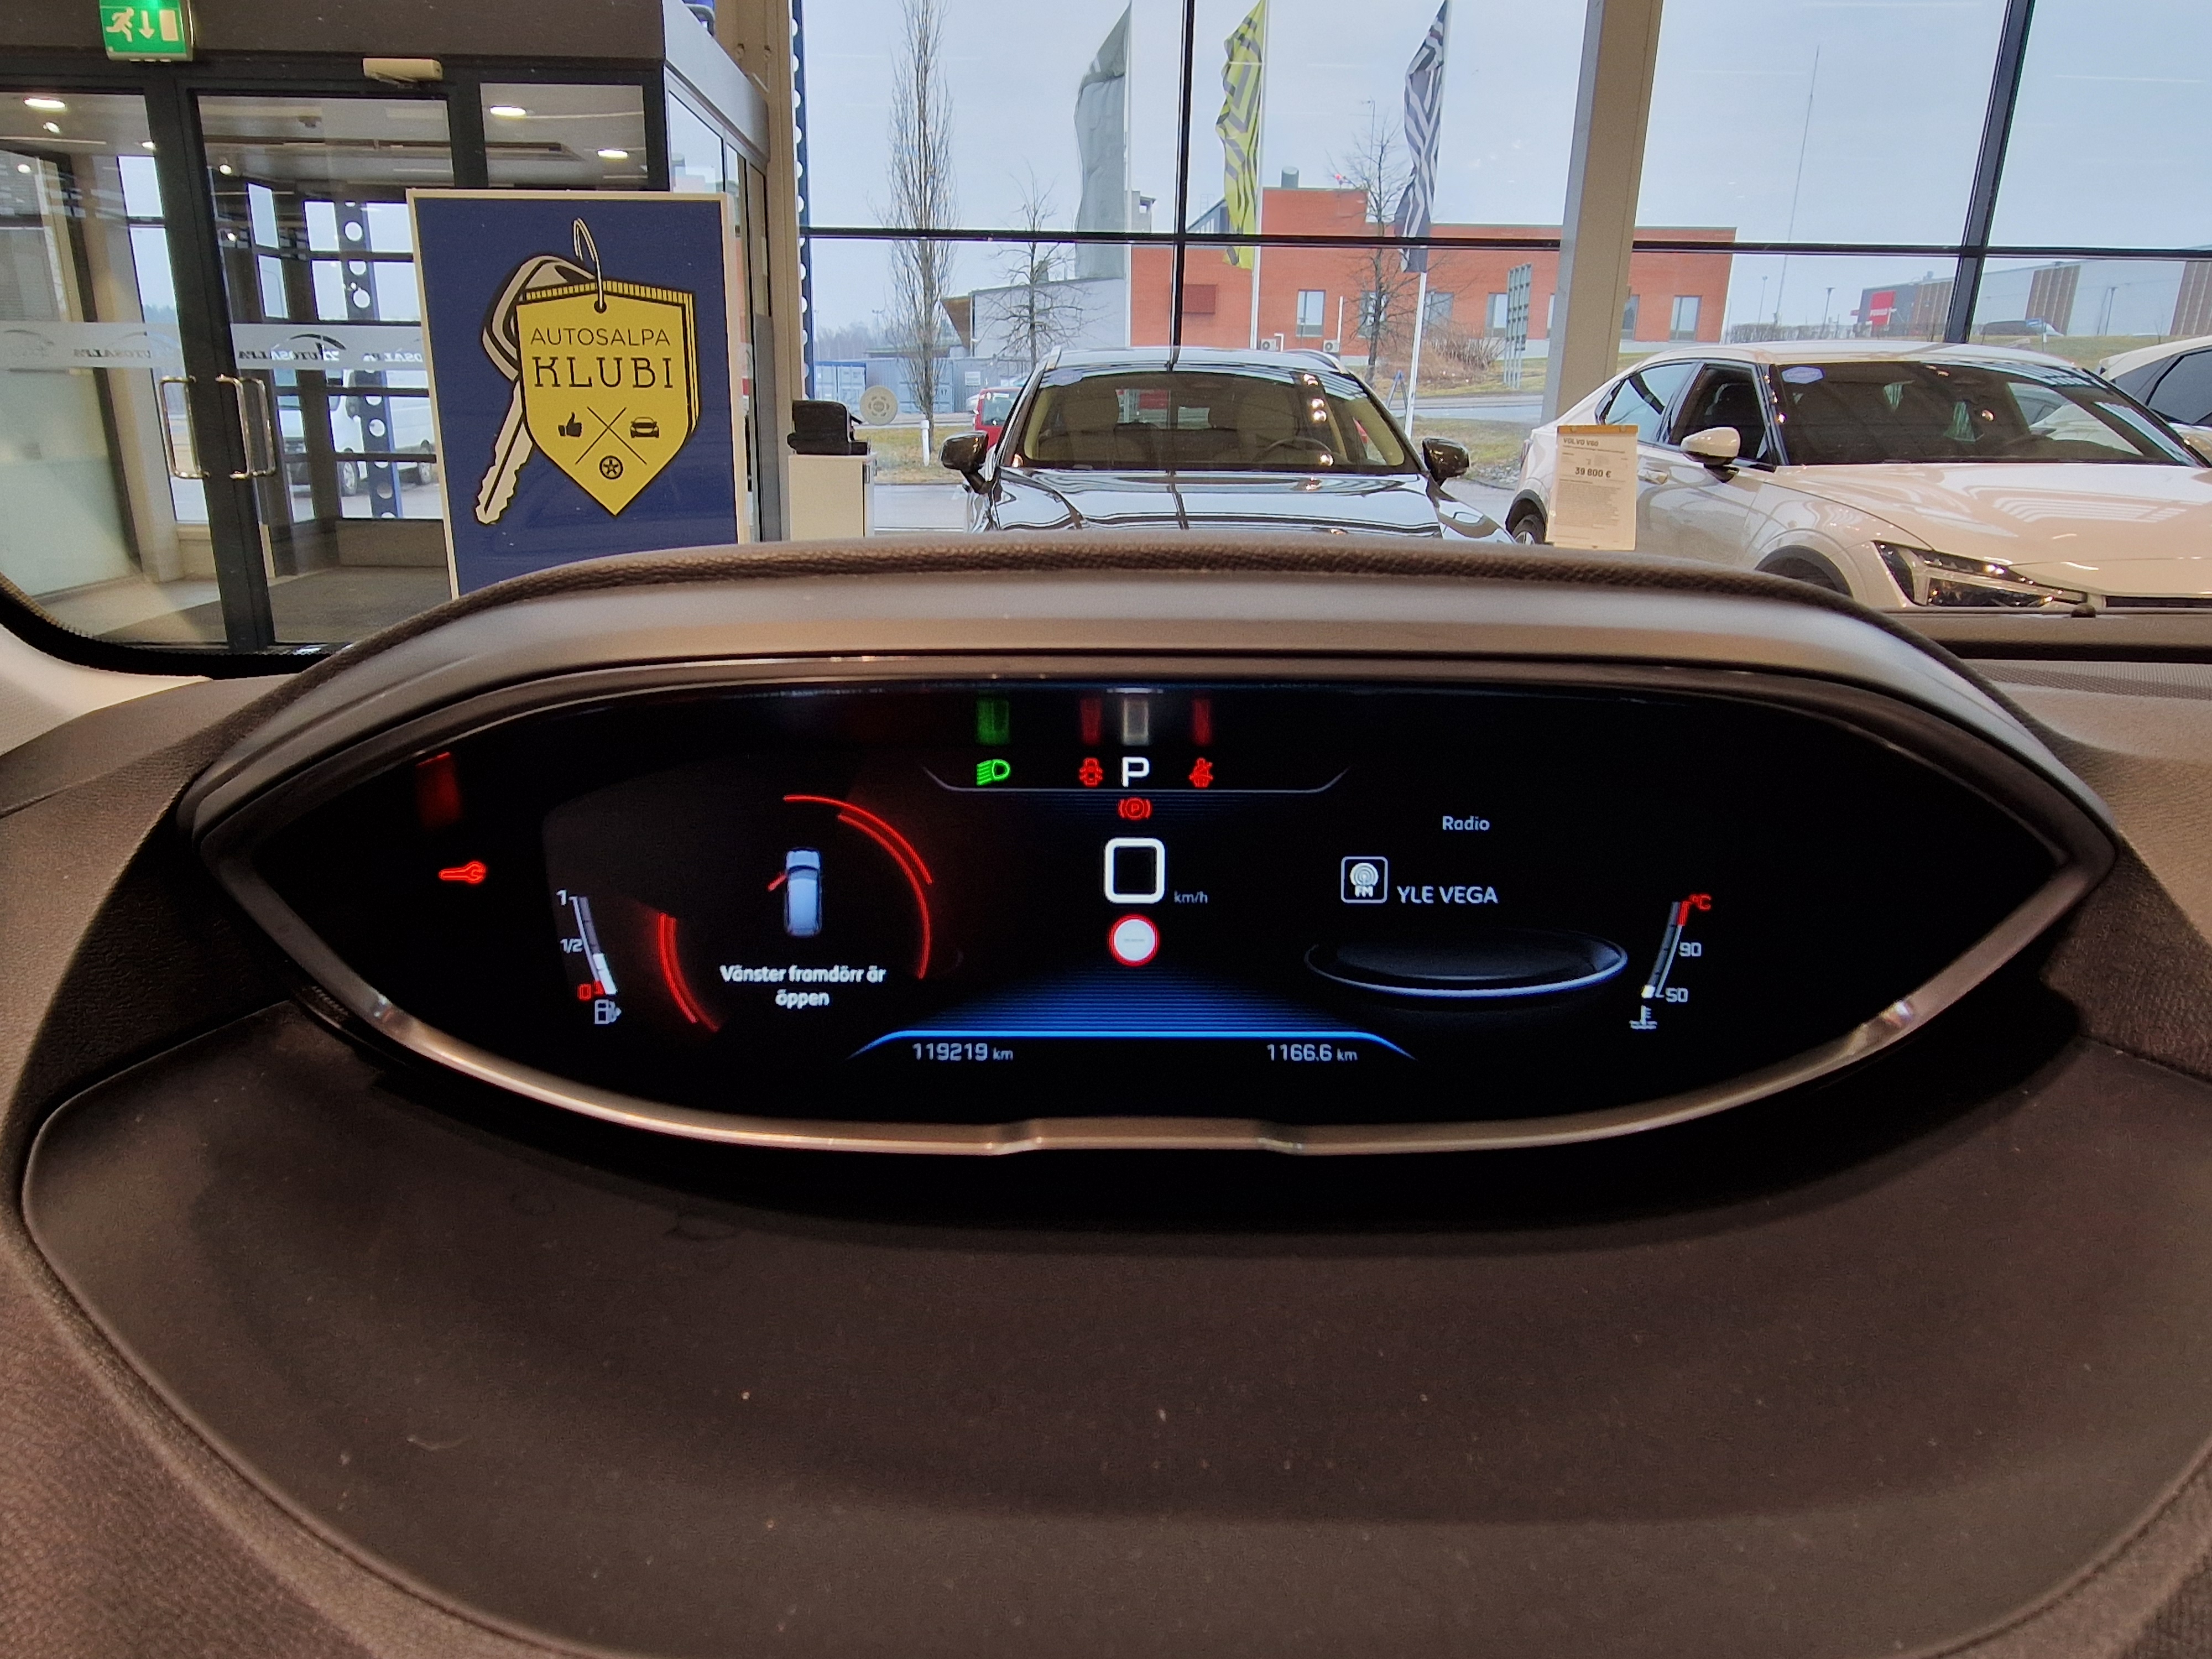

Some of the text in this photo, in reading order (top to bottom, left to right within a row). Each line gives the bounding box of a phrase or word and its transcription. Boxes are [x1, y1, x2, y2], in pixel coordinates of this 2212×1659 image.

[530, 327, 670, 346] AUTOSALPA
[532, 356, 674, 388] KLUBI
[1563, 437, 1585, 446] VOLVO
[1575, 467, 1585, 475] 39
[1121, 757, 1150, 787] P
[1442, 816, 1490, 831] Radio
[1105, 837, 1165, 904] 0
[556, 889, 566, 906] 1
[1173, 890, 1208, 904] km/h
[1396, 886, 1499, 904] YLE VEGA
[560, 938, 582, 953] 1/2
[1679, 942, 1702, 957] 90
[719, 964, 886, 983] Vänster framdörr är
[775, 989, 830, 1009] öppen
[1665, 988, 1688, 1003] 50
[912, 1043, 1013, 1061] 119219 km
[1267, 1044, 1358, 1061] 1166.6 km
